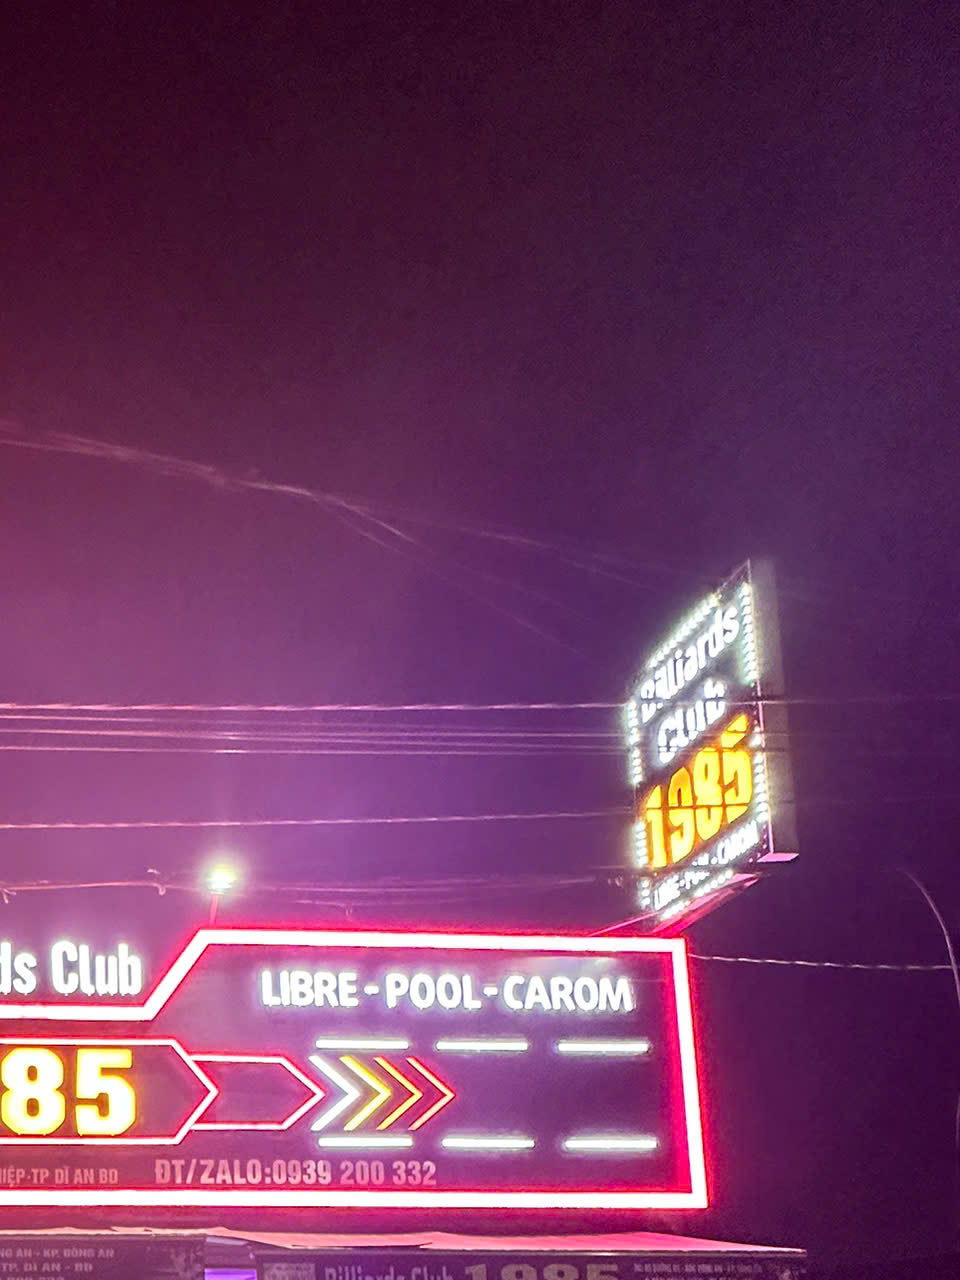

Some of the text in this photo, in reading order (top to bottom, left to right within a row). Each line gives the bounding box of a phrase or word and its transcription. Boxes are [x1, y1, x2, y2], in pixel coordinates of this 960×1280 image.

[644, 714, 753, 868] 1985
[50, 939, 142, 996] Club
[261, 970, 359, 1008] LIBRE
[385, 973, 482, 1009] POOL
[502, 975, 635, 1012] CAROM
[74, 1168, 95, 1184] AN
[340, 1160, 385, 1185] 200
[392, 1160, 437, 1185] 332
